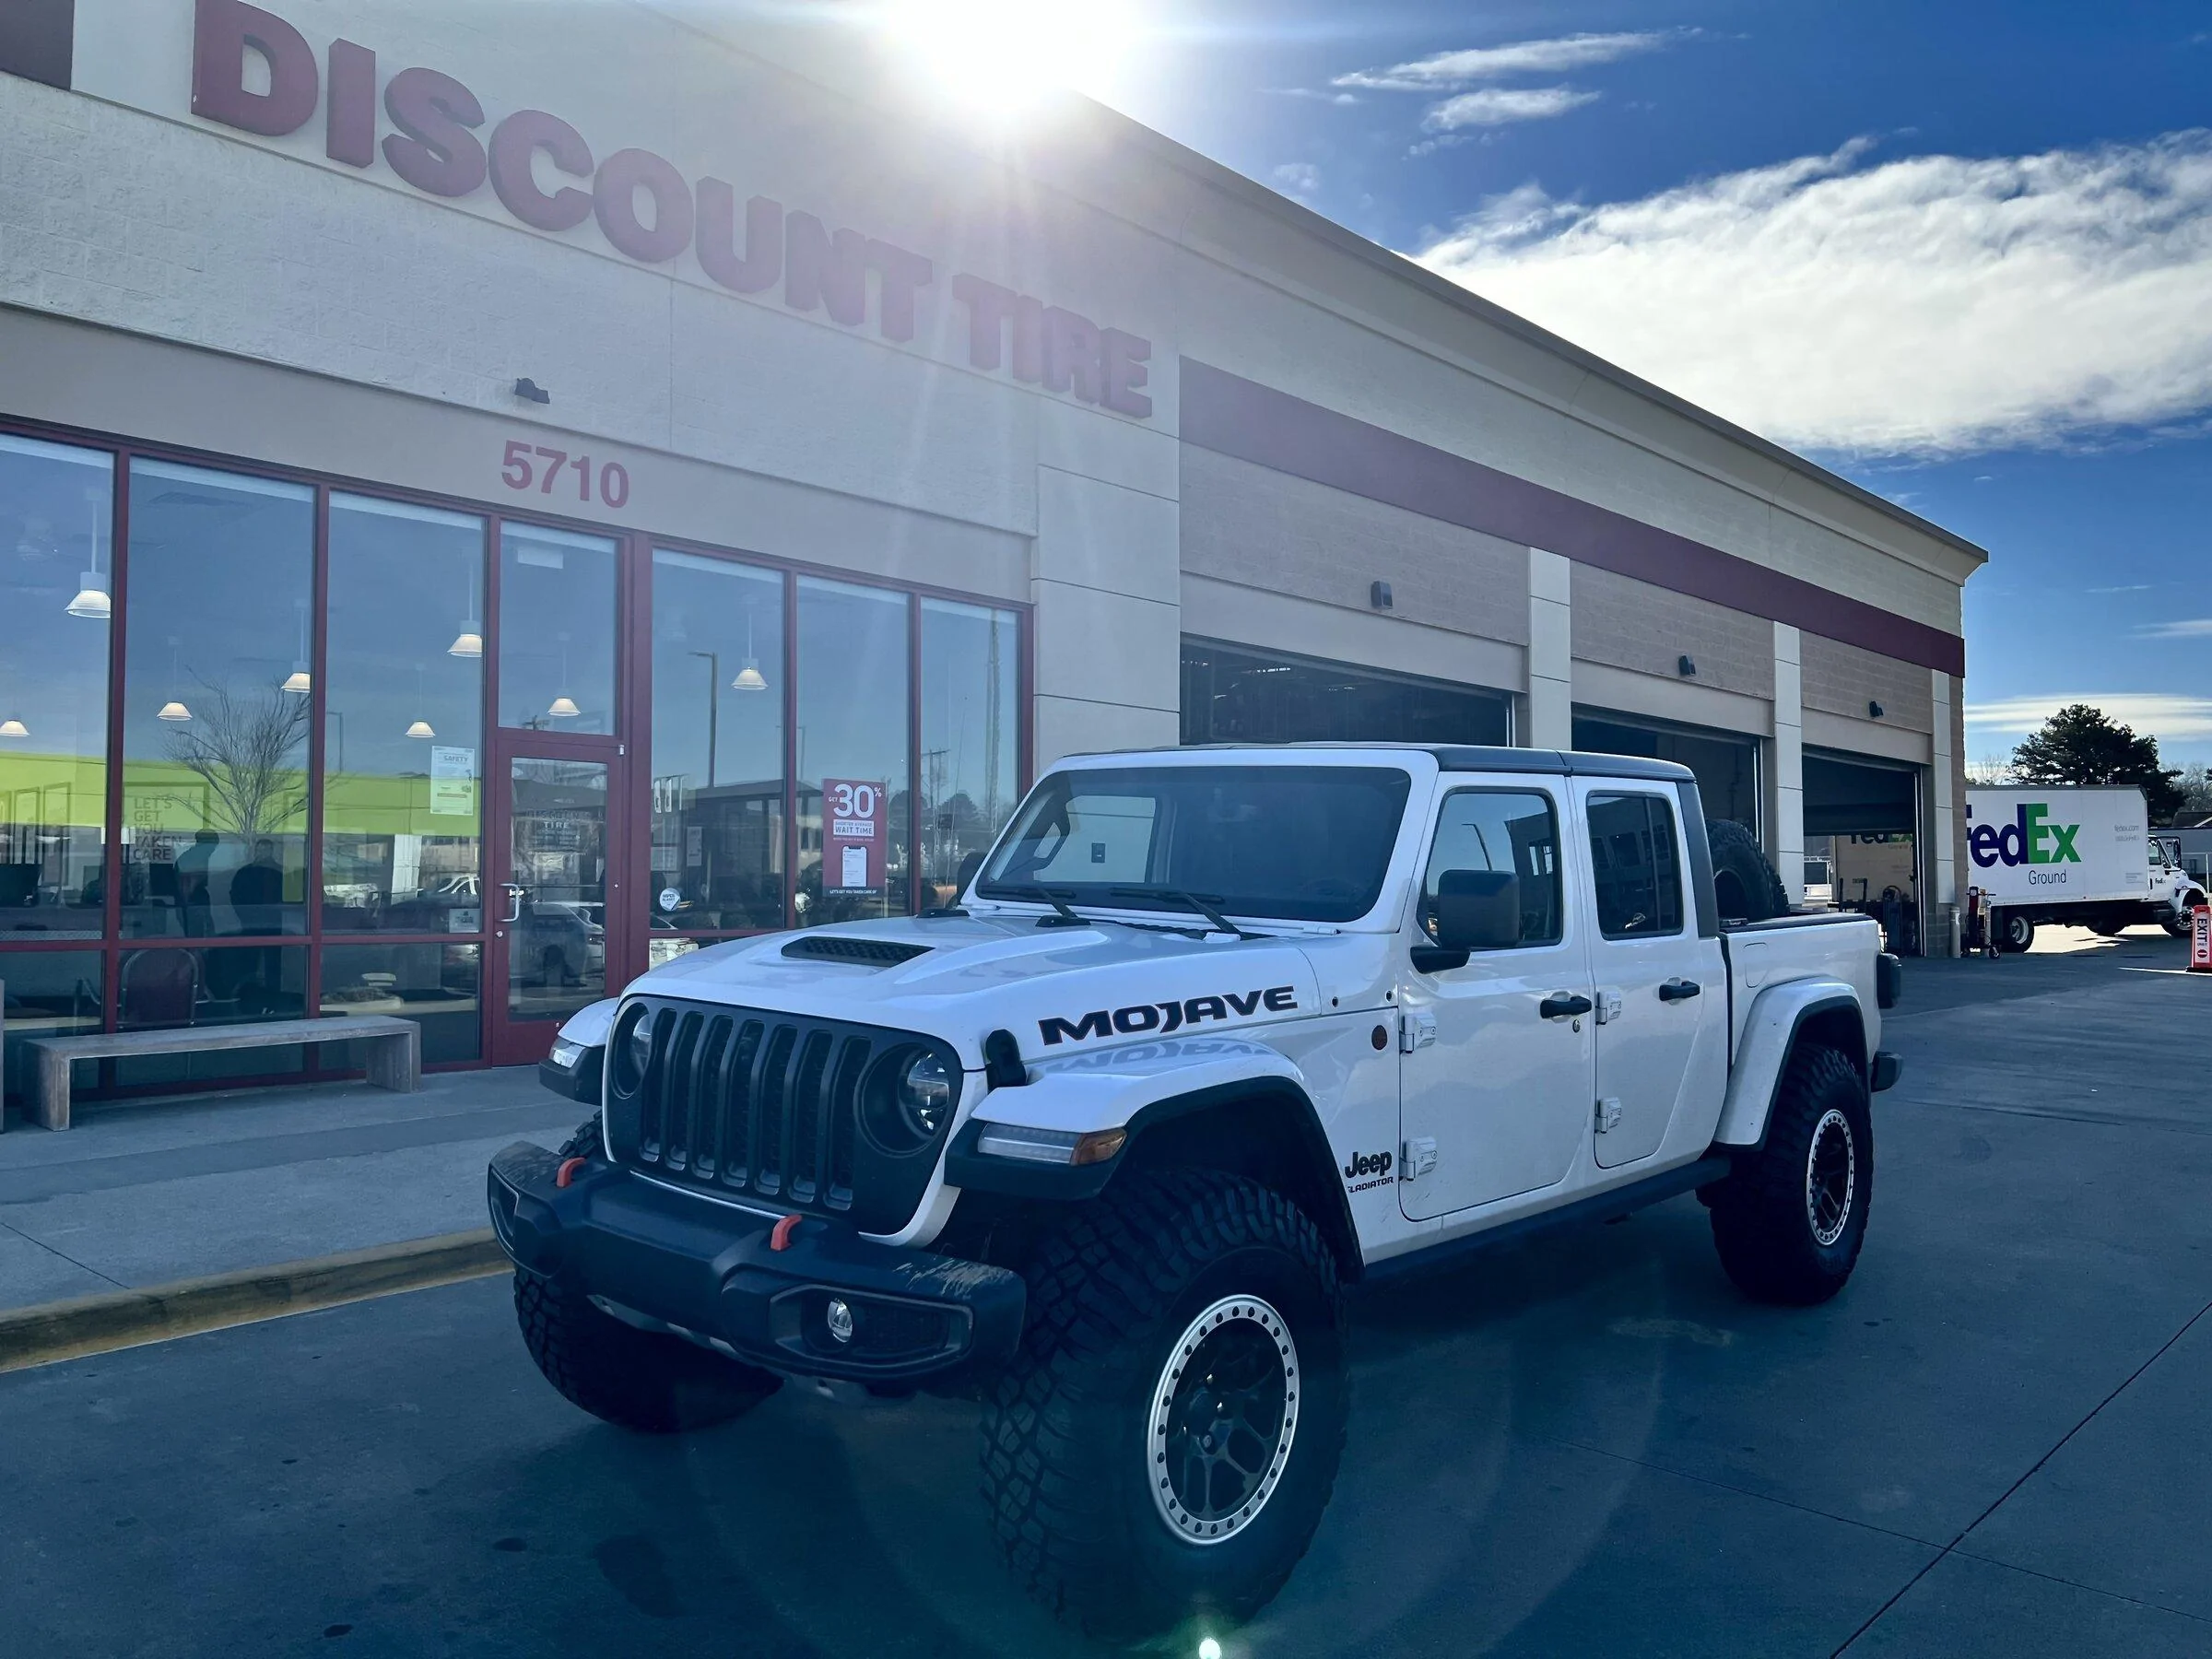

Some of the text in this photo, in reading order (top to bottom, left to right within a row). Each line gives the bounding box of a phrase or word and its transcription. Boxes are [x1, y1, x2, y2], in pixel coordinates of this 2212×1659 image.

[191, 0, 1152, 418] DISCOUNT TIRE
[501, 440, 629, 508] 5710
[134, 810, 160, 822] GET
[835, 826, 873, 835] WAIT TIME
[134, 848, 172, 861] CARE
[2029, 869, 2066, 885] Ground
[2197, 918, 2207, 942] EXIT
[1038, 985, 1298, 1046] MOJAVE
[1345, 1151, 1392, 1178] Jeep
